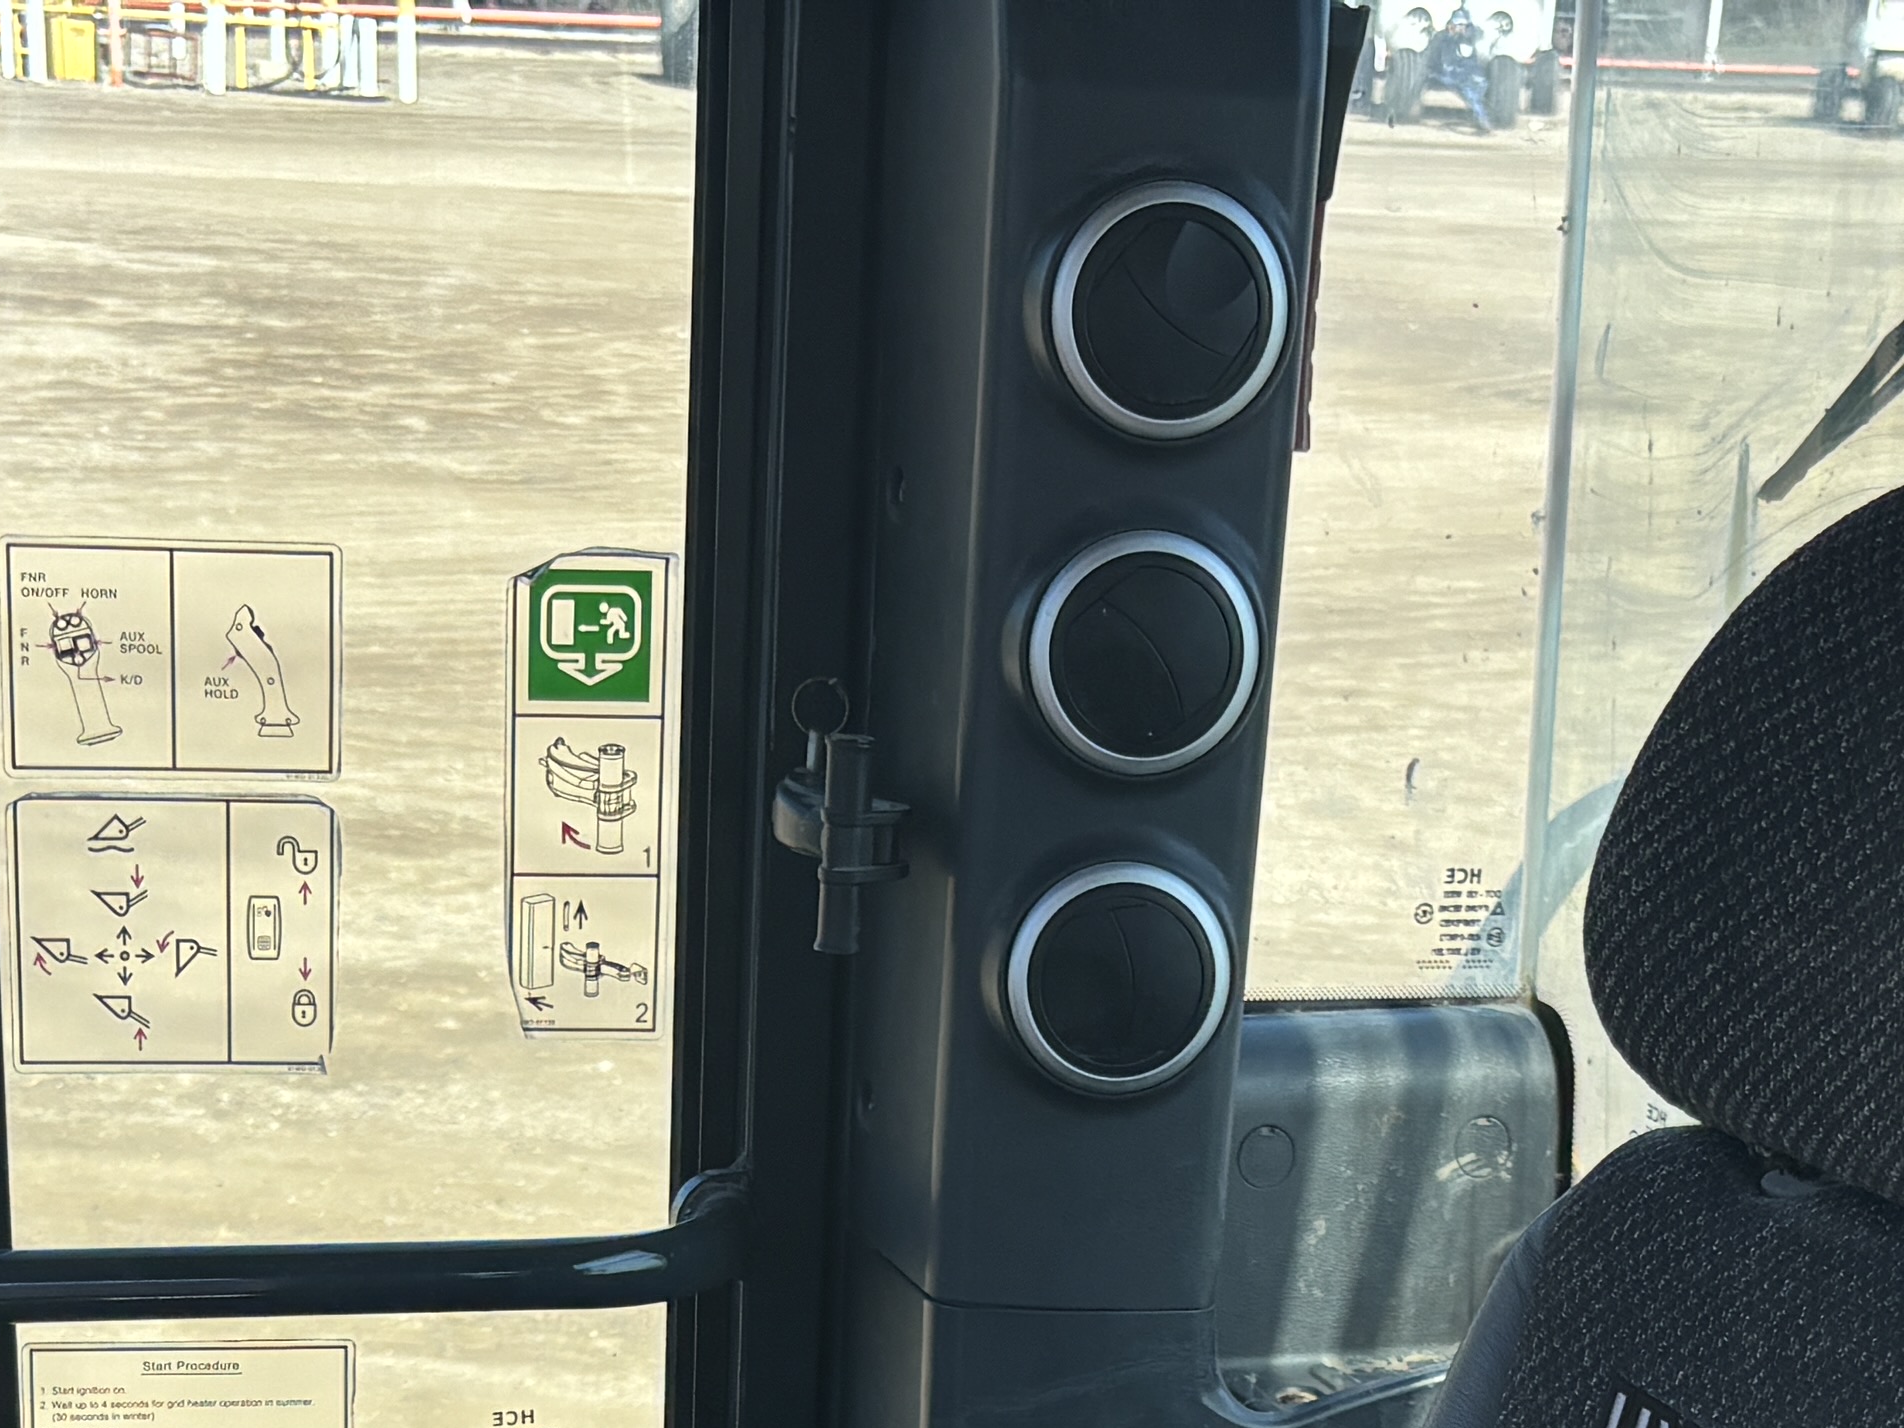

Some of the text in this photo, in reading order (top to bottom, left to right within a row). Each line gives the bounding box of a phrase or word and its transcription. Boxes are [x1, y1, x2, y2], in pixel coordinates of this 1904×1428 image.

[20, 572, 46, 582] FNR
[21, 588, 117, 598] ON/OFF HORN
[20, 628, 27, 638] F
[119, 631, 145, 642] AUX
[20, 642, 29, 652] N
[119, 644, 162, 655] SPOOL
[21, 656, 30, 666] R
[120, 675, 143, 686] K/D
[205, 676, 230, 686] AUX
[205, 689, 239, 699] HOLD
[643, 846, 652, 868] 1
[635, 1003, 649, 1024] 2
[142, 1360, 239, 1370] Start Procedure
[52, 1386, 73, 1394] Start
[76, 1386, 110, 1395] ignition
[110, 1400, 148, 1408] seconds
[167, 1400, 184, 1409] grid
[219, 1399, 262, 1408] operation
[123, 1412, 154, 1421] winter)
